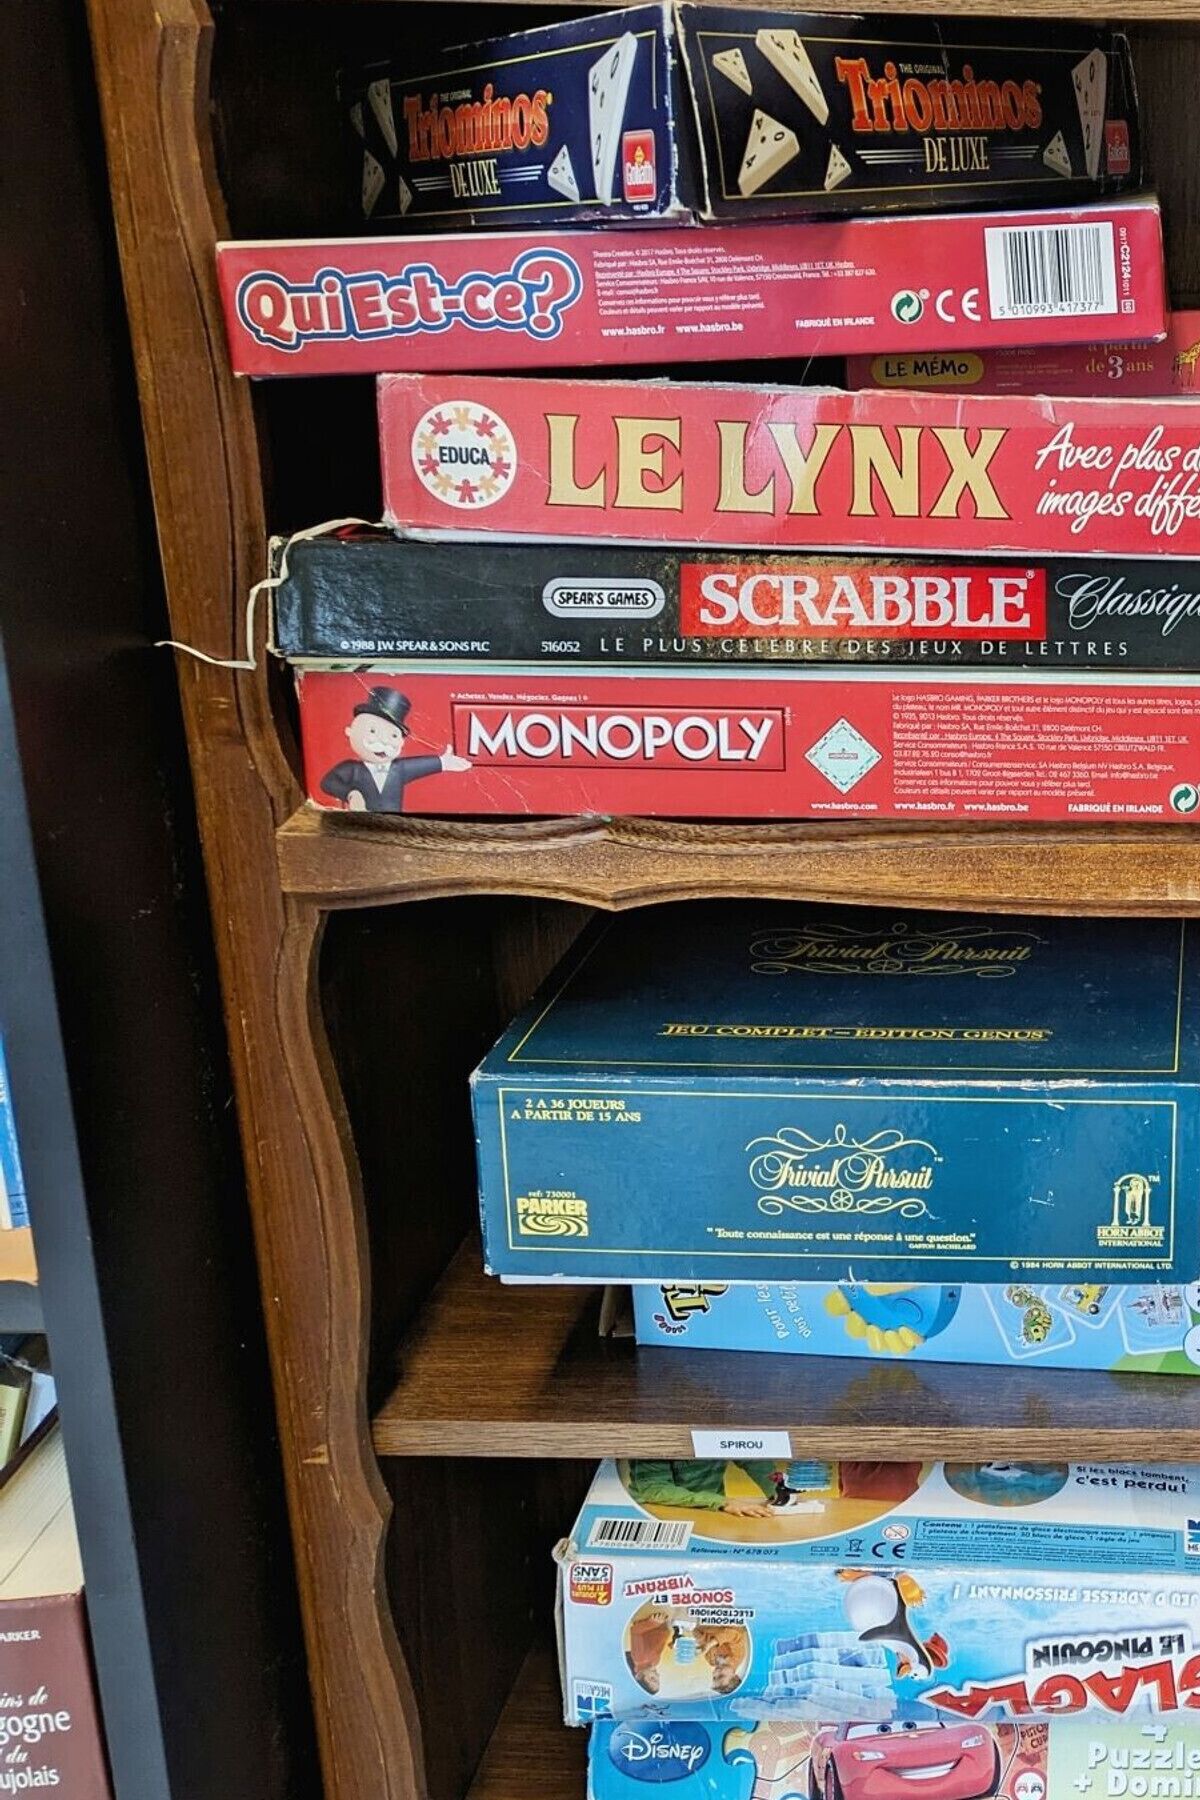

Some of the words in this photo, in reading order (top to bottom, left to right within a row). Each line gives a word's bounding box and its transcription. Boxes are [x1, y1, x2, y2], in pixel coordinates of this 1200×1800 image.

[835, 57, 1043, 131] Triominos
[404, 83, 549, 162] Triominos
[924, 137, 946, 173] DE
[948, 136, 990, 171] LUXE
[246, 278, 344, 342] Qui
[601, 325, 665, 336] www.hasbro.fr
[676, 321, 744, 333] www.hasbro.be
[885, 361, 907, 378] LE
[1086, 359, 1105, 373] de
[1107, 355, 1124, 379] 3
[1126, 362, 1154, 372] ans
[439, 444, 490, 466] EDUCA
[1035, 422, 1113, 474] Avec
[1107, 425, 1178, 490] plus
[544, 413, 685, 513] LE
[714, 420, 1010, 519] LYNX
[1036, 479, 1131, 534] images
[558, 590, 603, 607] SPEAR'S
[606, 590, 651, 607] GAMES
[699, 573, 1031, 628] SCRABBLE
[351, 640, 375, 650] 1988
[470, 641, 490, 652] PLC
[541, 641, 580, 653] 516052
[600, 637, 624, 652] LE
[643, 637, 702, 653] PLUS
[847, 640, 891, 655] DES
[909, 641, 963, 656] JEUX
[981, 641, 1008, 656] DE
[1024, 641, 1128, 657] LETTRES
[467, 710, 773, 762] MONOPOLY
[811, 802, 878, 812] www.hasbro.com
[894, 802, 956, 812] www.hasbro.fr
[963, 803, 1030, 813] www.hasbro.be
[1068, 802, 1111, 813] FABRIQUÉ
[1112, 803, 1125, 813] EN
[1125, 803, 1164, 814] IRLANDE
[749, 937, 888, 962] Trivial
[884, 938, 1031, 963] Pursuit
[663, 1025, 709, 1037] JEU
[714, 1026, 832, 1038] COMPLET
[854, 1028, 954, 1039] EDITION
[962, 1029, 1045, 1040] GENUS
[525, 1099, 533, 1109] 2
[536, 1099, 547, 1109] A
[550, 1099, 565, 1109] 36
[568, 1099, 625, 1110] JOUEURS
[511, 1110, 521, 1121] A
[524, 1110, 573, 1121] PARTIR
[577, 1110, 595, 1121] DE
[599, 1110, 611, 1121] 15
[615, 1110, 642, 1121] ANS
[749, 1149, 839, 1191] Trivial
[838, 1152, 933, 1192] Pursuit
[516, 1198, 588, 1216] PARKER
[746, 1230, 814, 1241] connaissance
[815, 1231, 830, 1241] est
[832, 1232, 852, 1241] une
[854, 1231, 894, 1244] réponse
[896, 1231, 903, 1242] à
[904, 1233, 924, 1243] une
[1097, 1227, 1128, 1238] HORN
[1130, 1227, 1165, 1238] ABBOT
[1021, 1261, 1040, 1269] 1984
[1042, 1261, 1064, 1269] HORN
[1066, 1261, 1092, 1269] ABBOT
[1094, 1261, 1154, 1269] INTERNATIONAL
[1156, 1261, 1174, 1269] LTD.
[719, 1440, 764, 1449] SPIROU
[1075, 1474, 1118, 1486] c'est
[574, 1566, 599, 1577] ANS
[625, 1577, 694, 1596] VIBRANT
[969, 1586, 1077, 1602] FRISSONNANT
[654, 1594, 669, 1604] ET
[672, 1591, 733, 1605] SONORE
[1171, 1592, 1199, 1607] JEU
[690, 1608, 755, 1618] ELECTRONIQUE
[701, 1617, 744, 1625] PINGOUIN
[1033, 1637, 1153, 1668] PINGOUIN
[1159, 1634, 1185, 1655] LE
[6, 1745, 28, 1763] du
